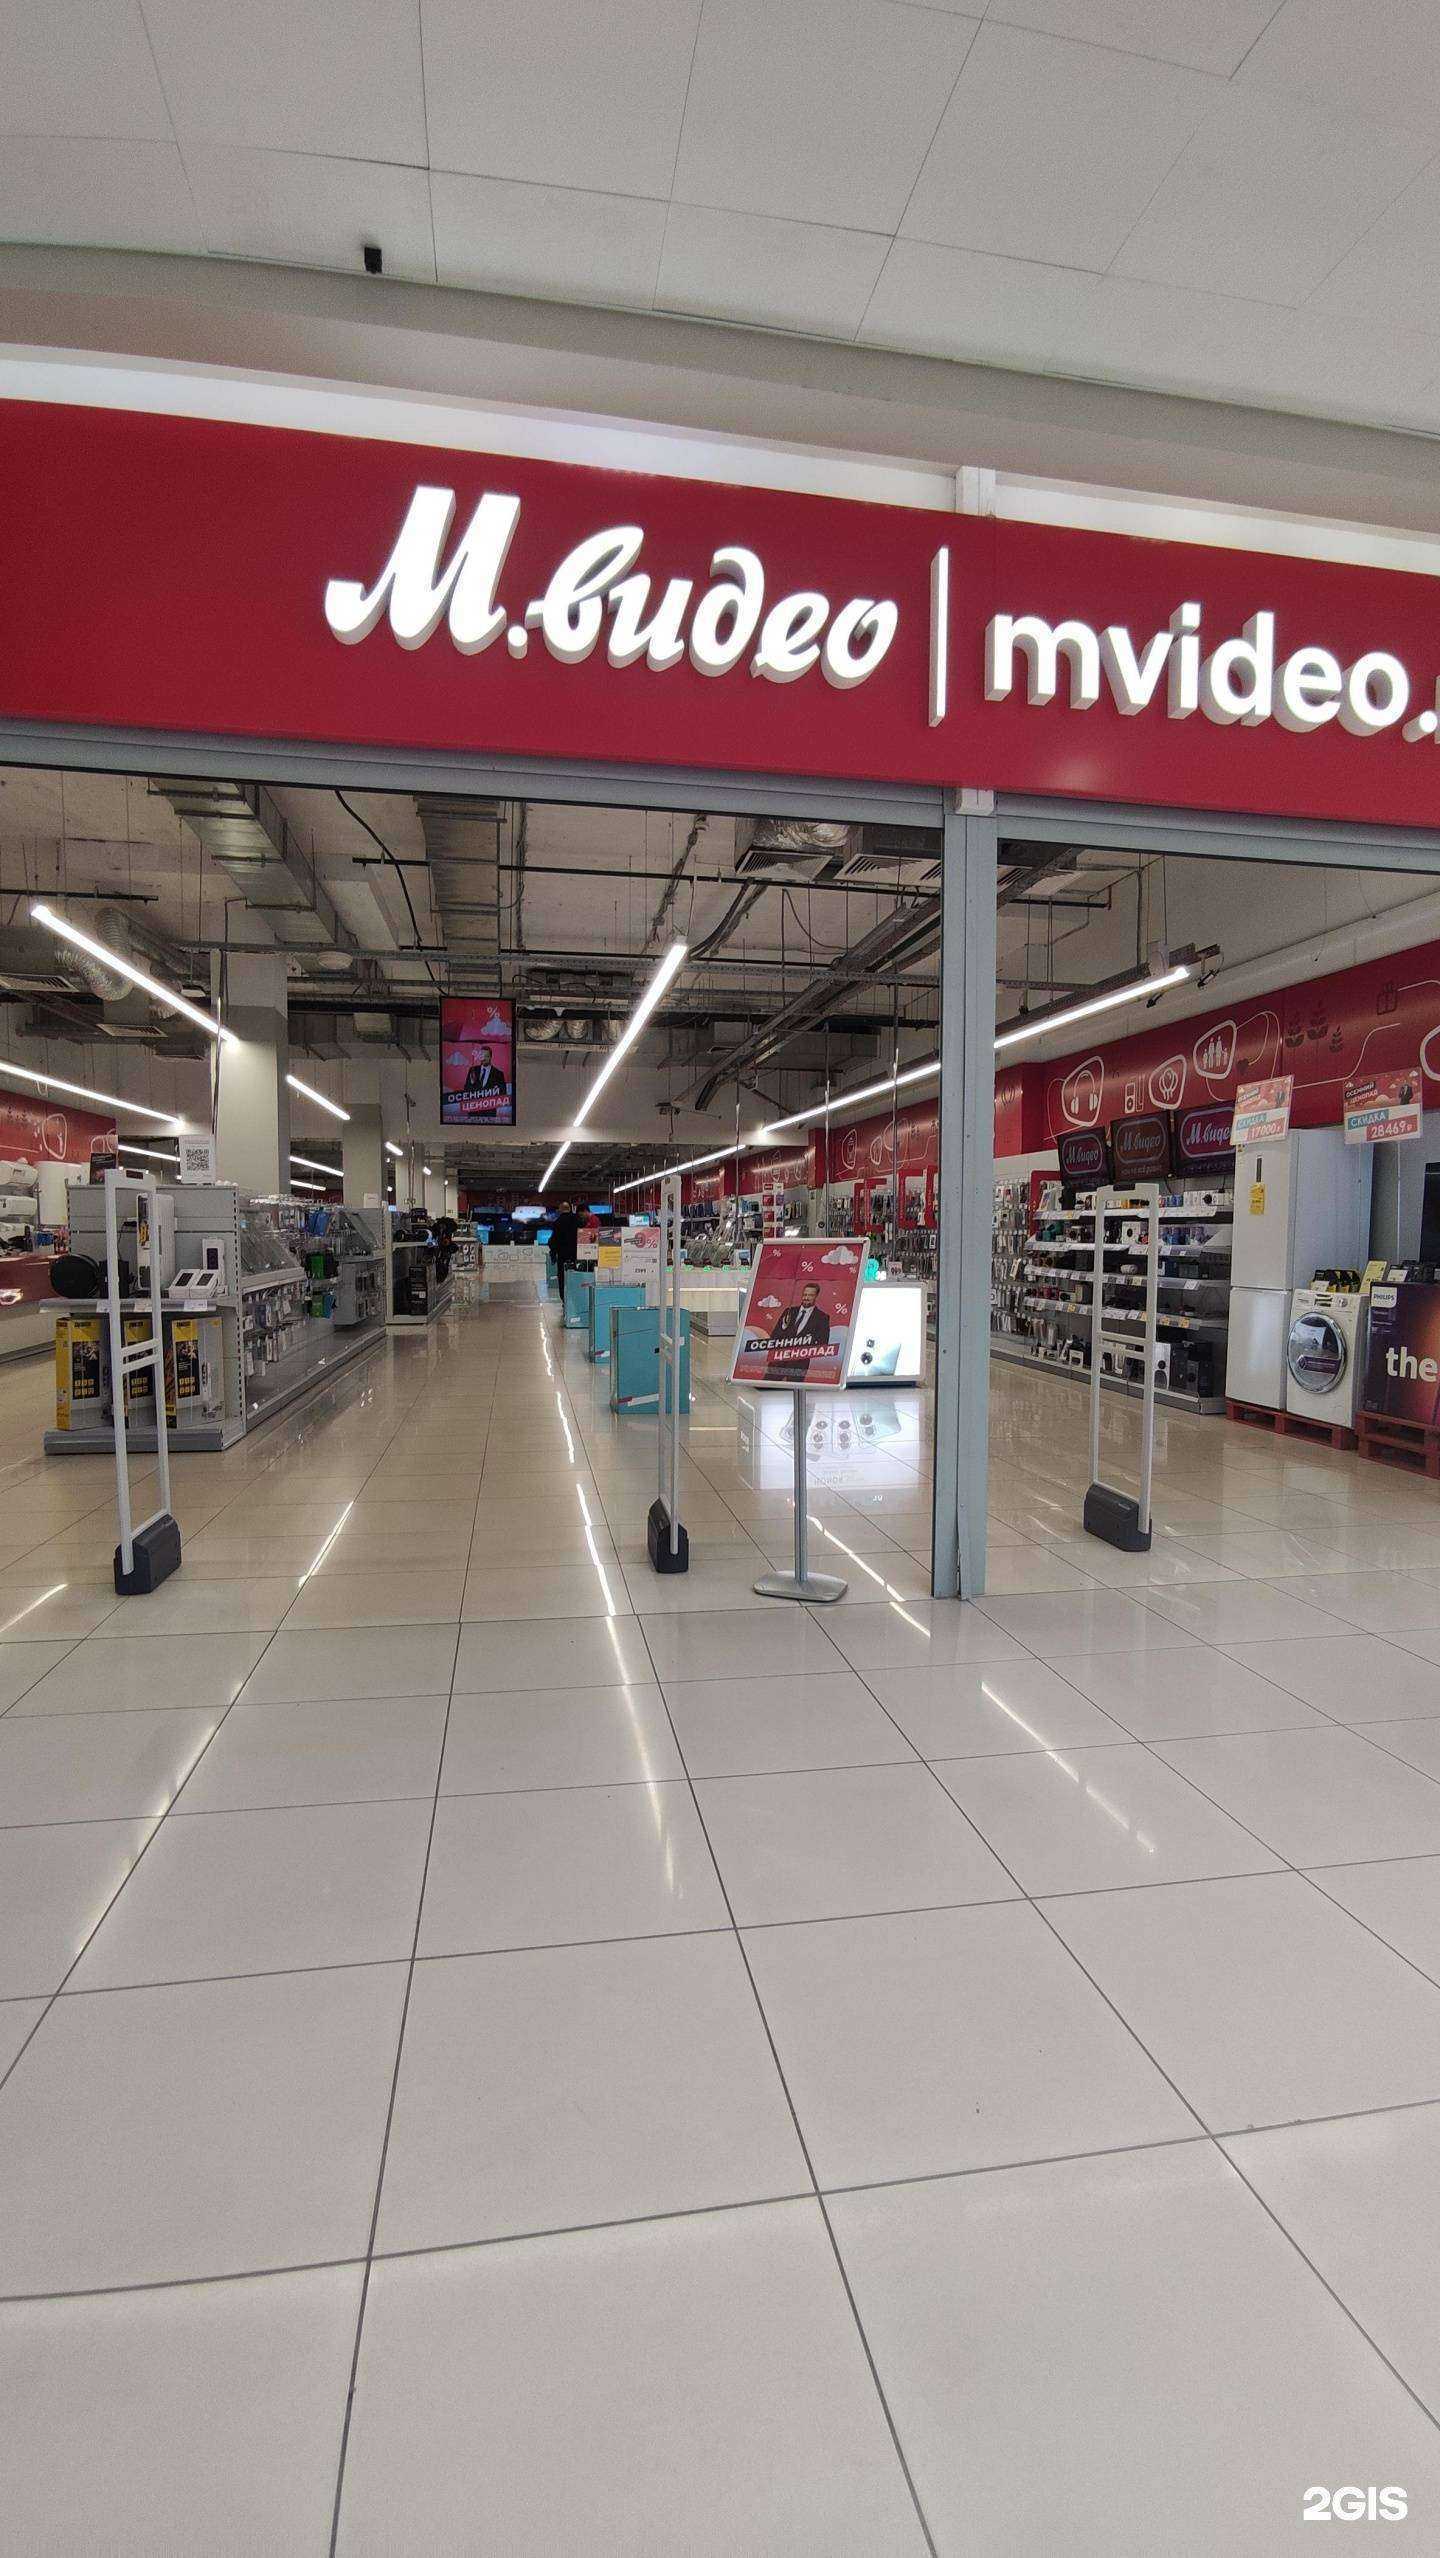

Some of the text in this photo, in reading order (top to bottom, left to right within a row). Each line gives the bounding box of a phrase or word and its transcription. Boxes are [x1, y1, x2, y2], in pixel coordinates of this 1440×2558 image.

[324, 485, 899, 688] М.видео
[986, 602, 1440, 742] mvideo.
[447, 1086, 500, 1103] ОСЕННИЙ
[462, 1097, 511, 1111] ЦЕНОПАД
[1350, 1111, 1386, 1128] СКИДКА
[1186, 1119, 1231, 1146] М.виде
[1373, 1293, 1395, 1301] PHILIPS
[750, 1334, 813, 1350] ОСЕННИЙ
[774, 1345, 835, 1361] ЦЕНОПАД
[1385, 1346, 1438, 1382] the
